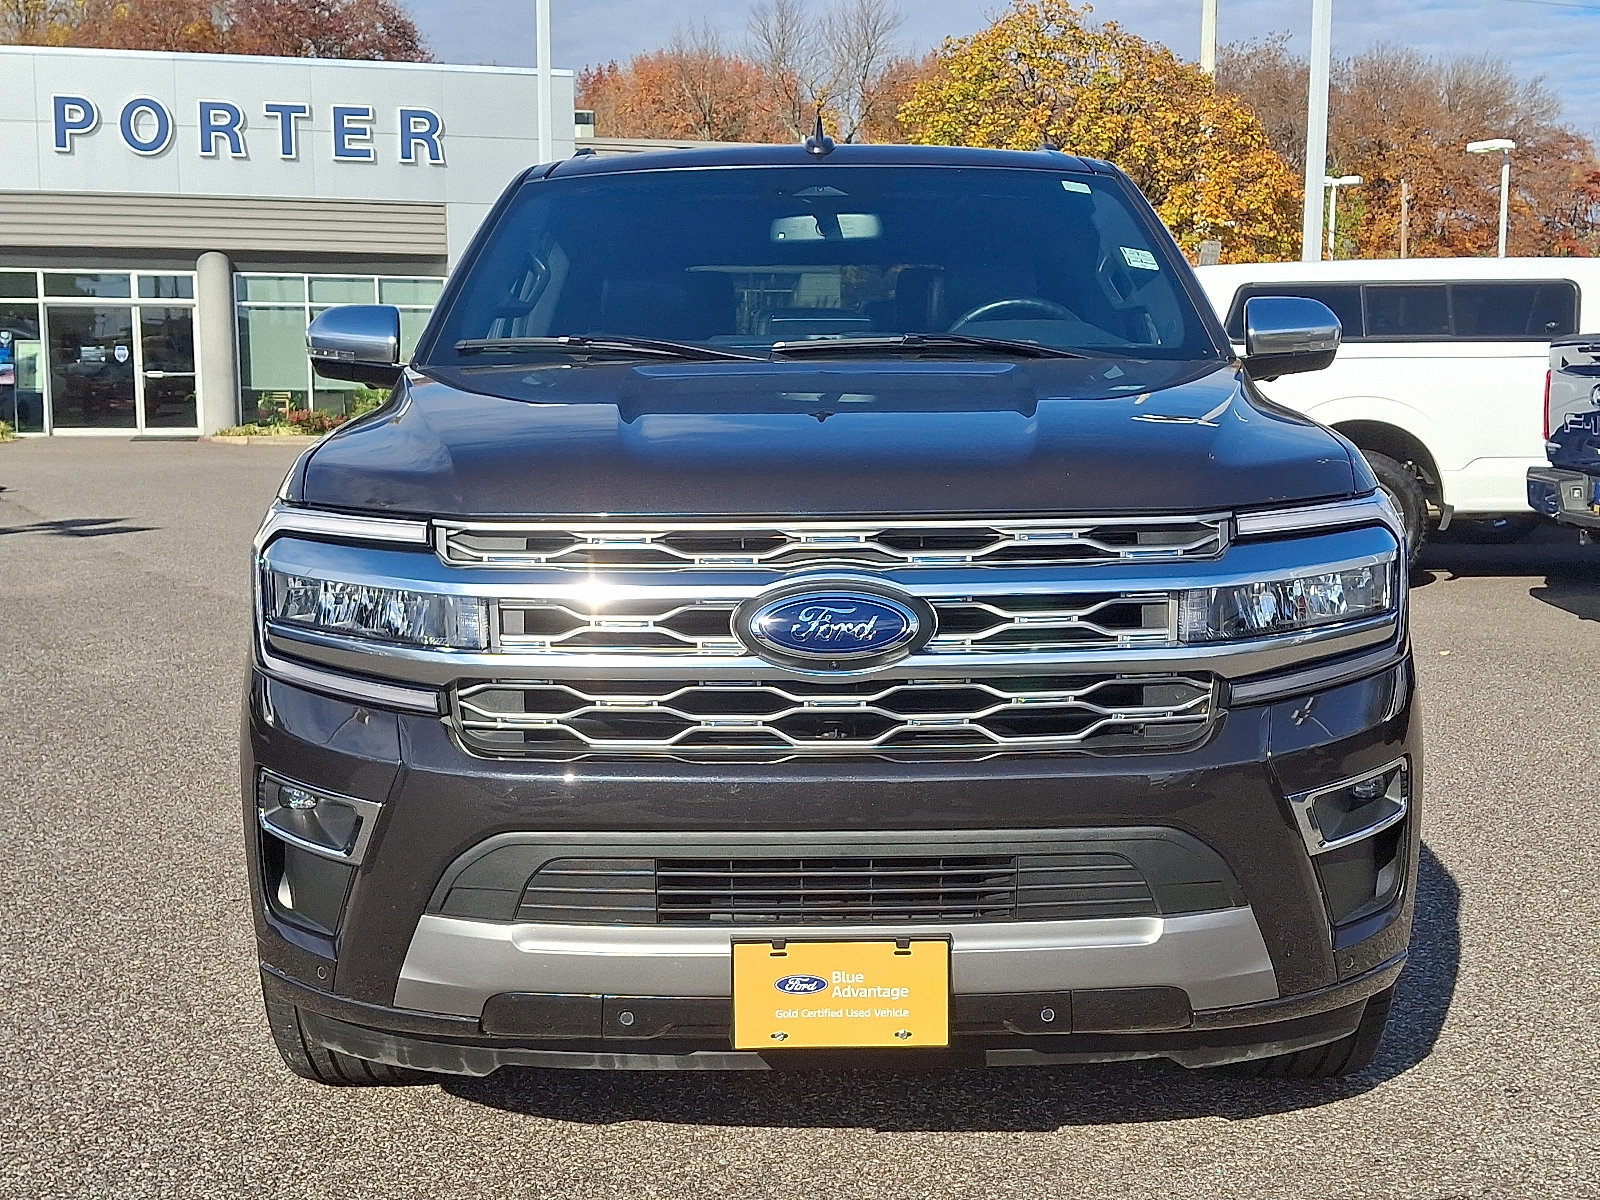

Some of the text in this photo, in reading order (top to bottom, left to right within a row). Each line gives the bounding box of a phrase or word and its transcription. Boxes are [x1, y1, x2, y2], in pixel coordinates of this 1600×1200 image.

[51, 92, 446, 165] PORTER
[791, 606, 880, 642] Ford
[784, 977, 818, 991] Ford
[831, 971, 864, 983] Blue
[831, 985, 909, 1000] Advantage
[775, 1007, 910, 1018] Gold Certified Used Vehicle
